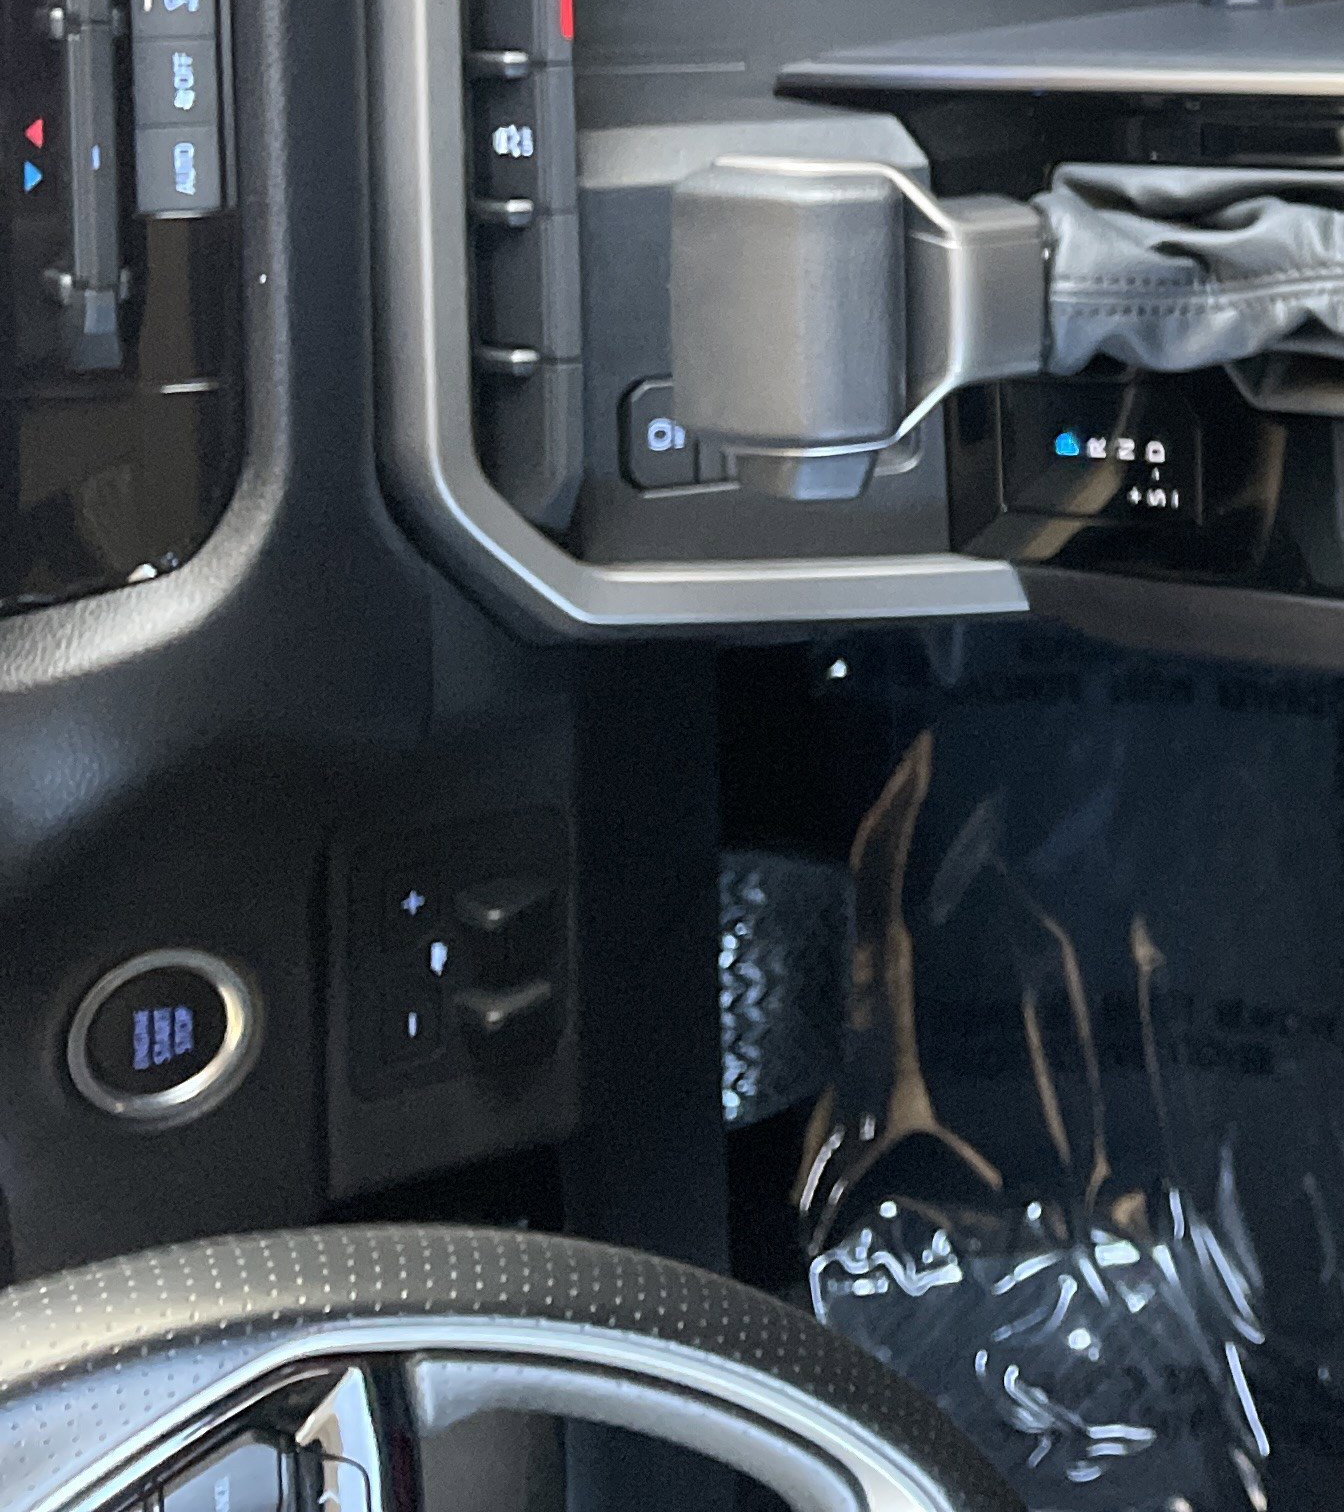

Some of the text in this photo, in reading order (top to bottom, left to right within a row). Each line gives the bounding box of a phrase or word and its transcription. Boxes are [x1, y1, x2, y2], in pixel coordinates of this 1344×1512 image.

[1086, 436, 1107, 459] R
[1116, 437, 1136, 461] N
[1145, 440, 1166, 464] D
[1146, 488, 1167, 508] S
